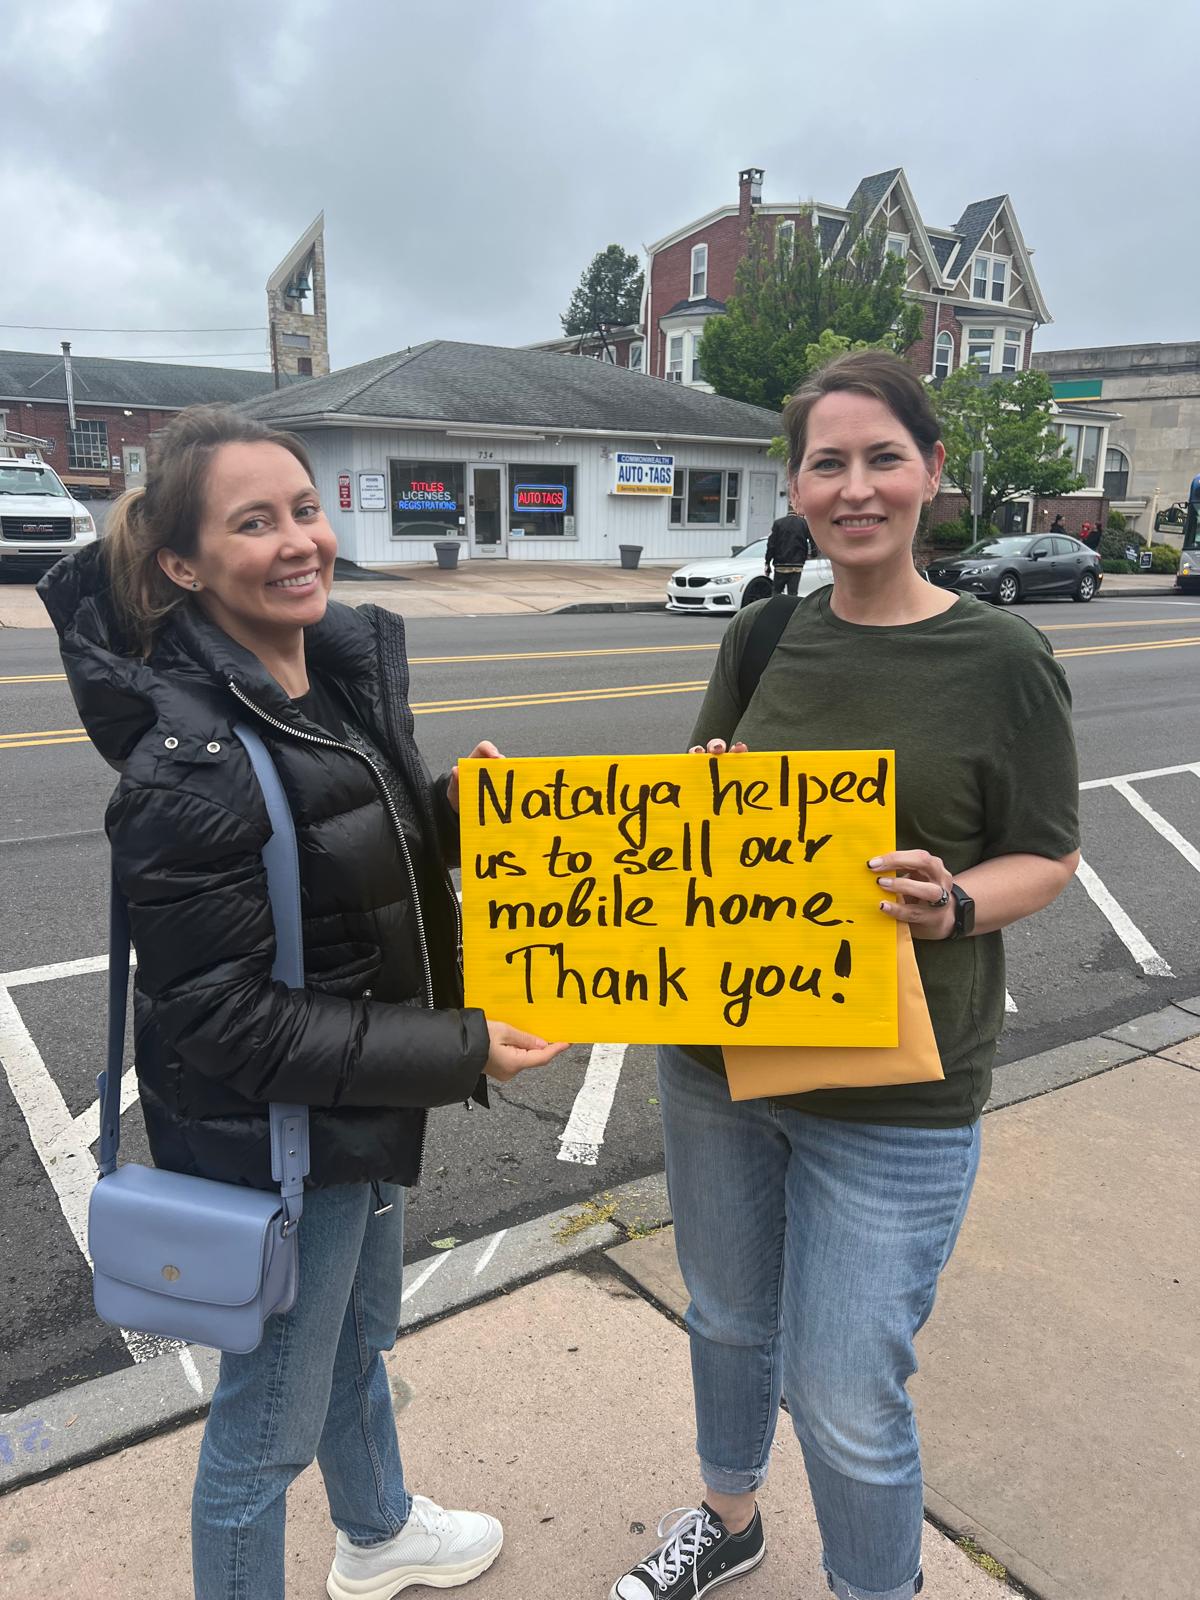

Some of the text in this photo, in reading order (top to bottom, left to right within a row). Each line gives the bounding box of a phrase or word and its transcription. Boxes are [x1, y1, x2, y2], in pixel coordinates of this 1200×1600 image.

[620, 455, 670, 464] COMMONWEALTH
[618, 465, 671, 484] AUTO TAGS
[410, 481, 445, 492] TITLES
[402, 491, 451, 501] LICENSES
[518, 491, 564, 505] AUTO TAGS
[398, 500, 457, 511] REGISTRATIONS
[478, 755, 888, 850] Natalya helped
[475, 819, 833, 880] us to sell our
[488, 873, 854, 930] mobile home.
[505, 939, 853, 1028] Thank you!
